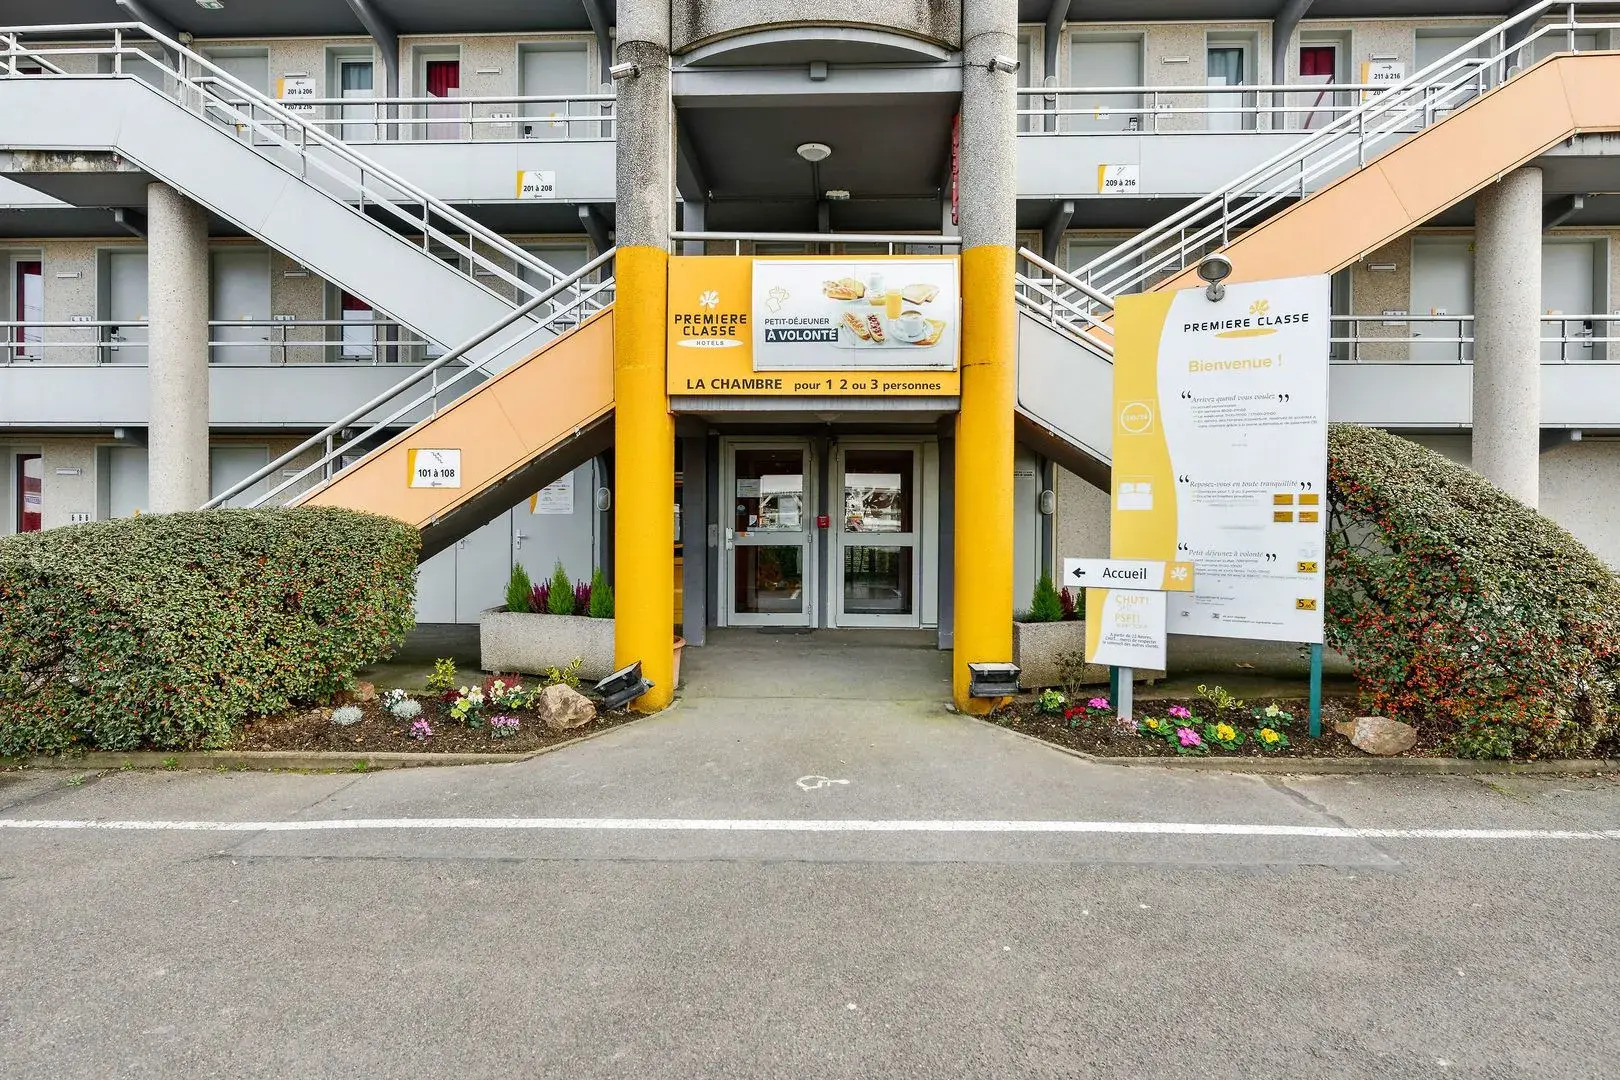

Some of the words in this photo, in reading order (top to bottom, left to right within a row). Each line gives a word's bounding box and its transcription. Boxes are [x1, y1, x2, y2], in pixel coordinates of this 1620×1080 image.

[1105, 179, 1118, 187] 209
[1124, 179, 1136, 187] 216
[674, 313, 748, 325] PREMIERE
[764, 316, 830, 326] PETIT-DÉJEUNER
[1183, 318, 1251, 333] PREMIERE
[1257, 313, 1310, 326] CLASSE
[682, 324, 737, 337] CLASSE
[766, 328, 775, 342] À
[777, 328, 838, 342] VOLONTÉ
[1188, 357, 1272, 373] Bienvenue
[686, 378, 706, 390] LA
[710, 378, 783, 390] CHAMBRE
[794, 382, 821, 392] pour
[826, 379, 833, 390] 1
[839, 379, 848, 390] 2
[852, 382, 867, 391] ou
[870, 379, 879, 390] 3
[882, 382, 942, 392] personnes
[418, 468, 431, 478] 101
[433, 467, 439, 478] à
[440, 468, 455, 478] 108
[1102, 567, 1147, 580] Accueil
